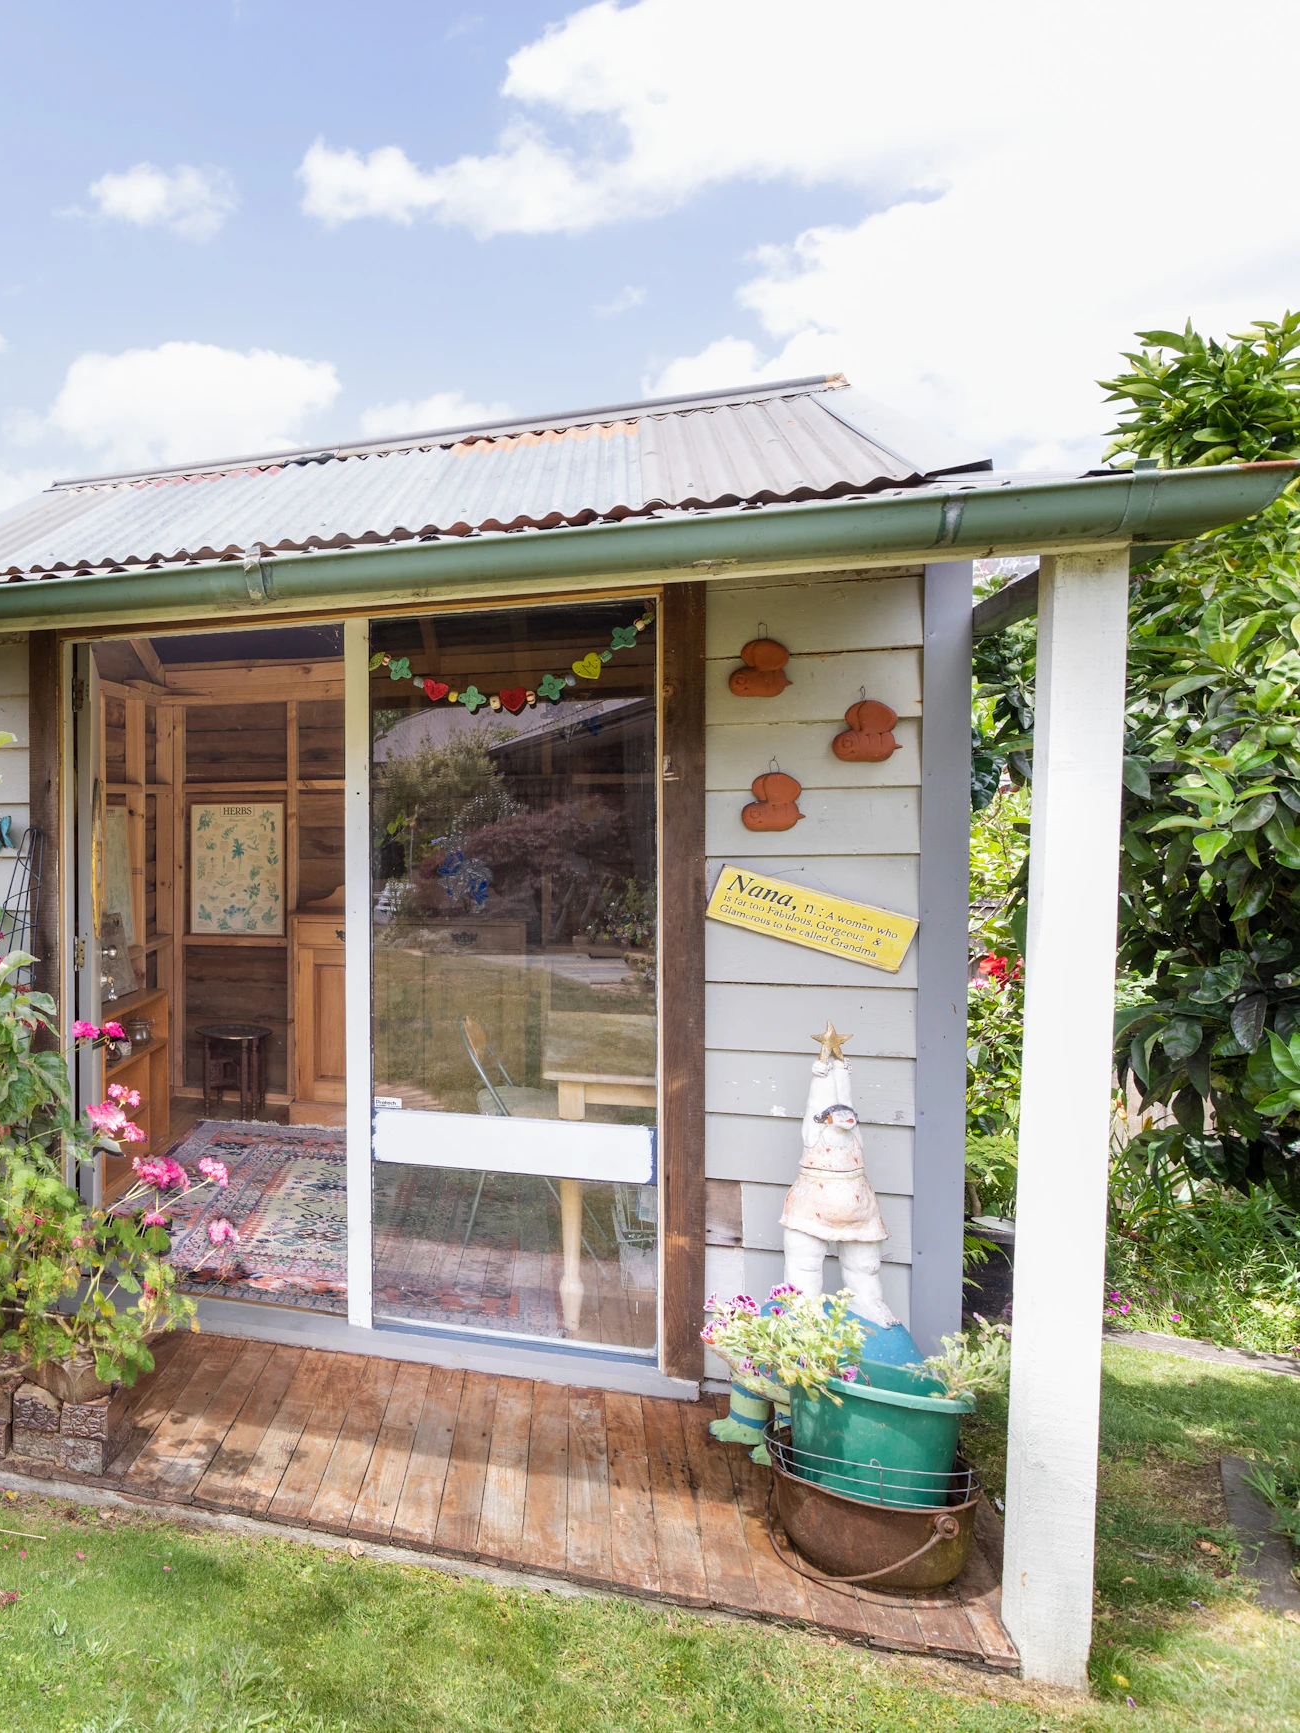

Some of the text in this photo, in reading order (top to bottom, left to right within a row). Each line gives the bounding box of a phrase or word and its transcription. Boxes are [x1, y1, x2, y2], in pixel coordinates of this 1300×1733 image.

[223, 807, 252, 815] HERBS
[720, 904, 877, 958] Glamorous to be called Grandma
[723, 893, 732, 903] is
[734, 896, 747, 907] far
[749, 902, 764, 911] too
[816, 921, 865, 941] Gorgeous
[872, 938, 882, 946] &
[727, 874, 797, 912] Nana,
[825, 912, 834, 921] A
[837, 915, 873, 932] woman
[877, 927, 898, 939] who
